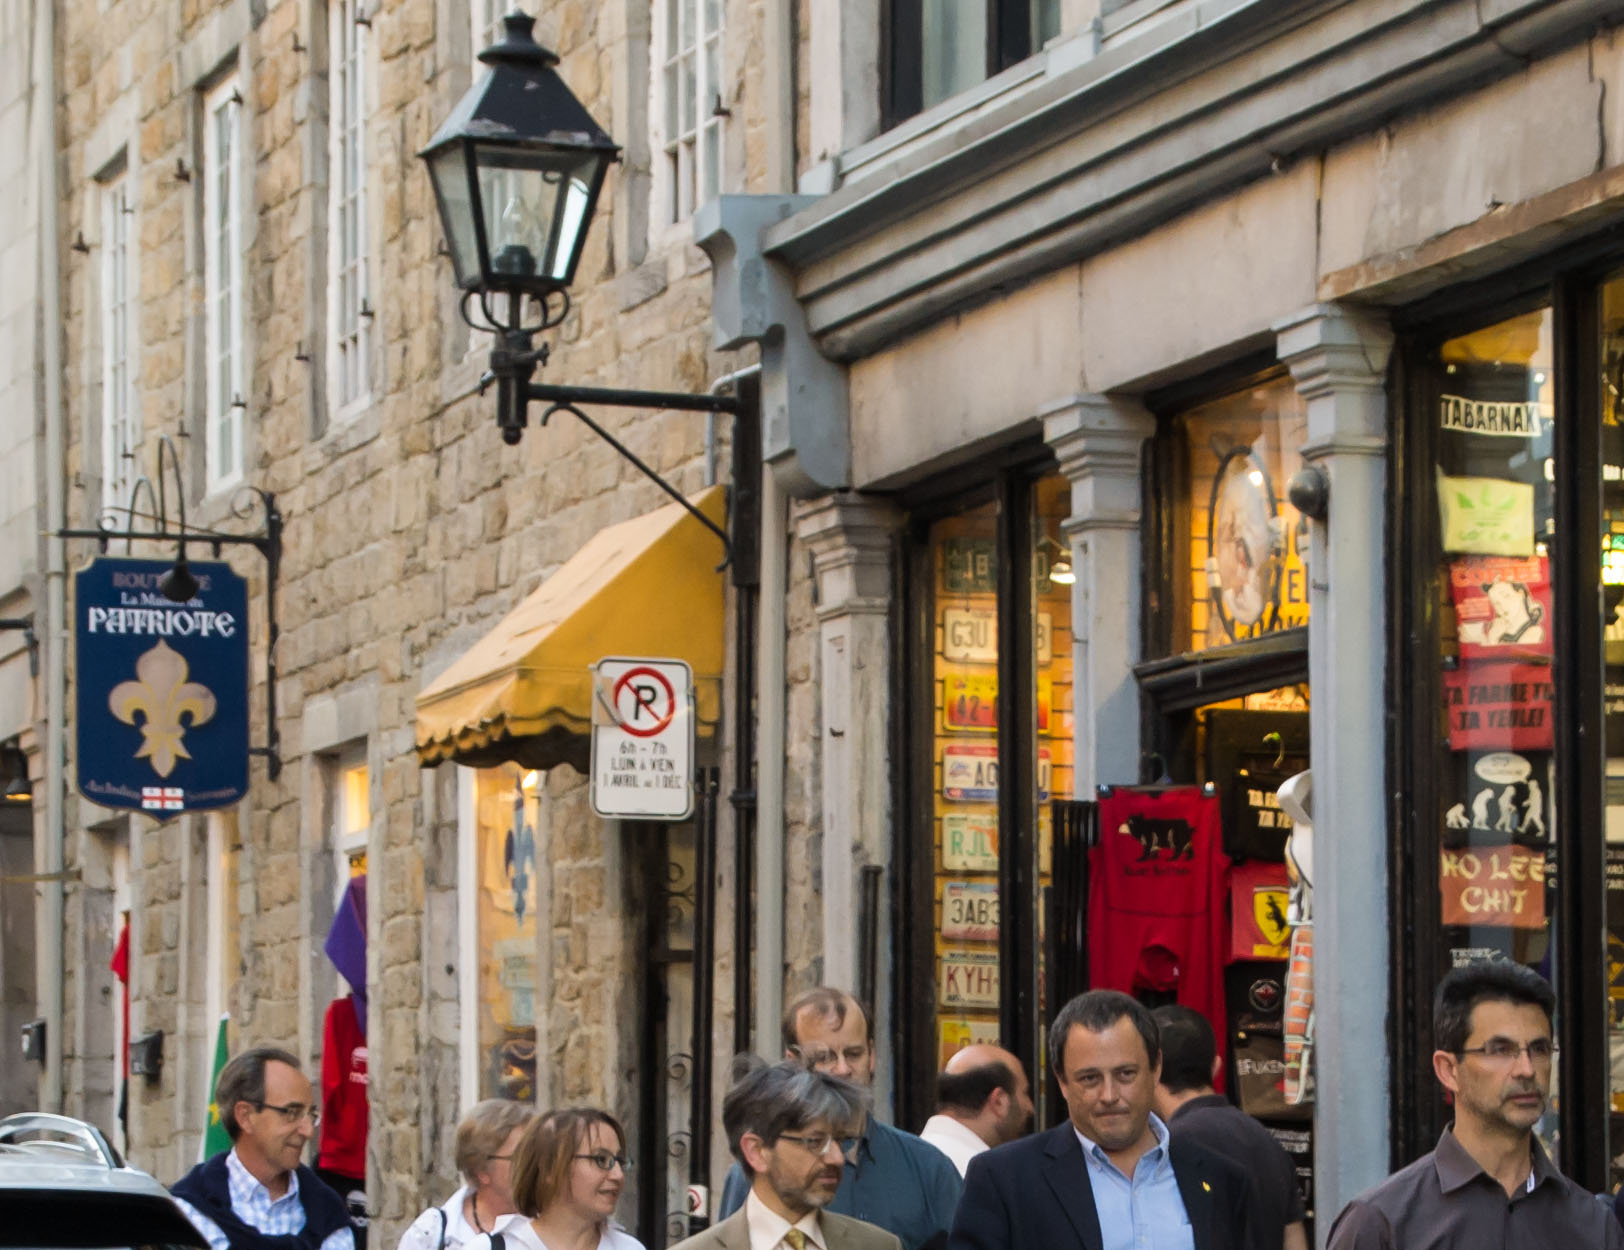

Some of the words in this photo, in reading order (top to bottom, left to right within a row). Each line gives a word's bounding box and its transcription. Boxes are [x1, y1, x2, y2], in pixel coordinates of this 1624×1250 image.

[1441, 400, 1536, 432] TABARNAK
[112, 572, 212, 592] BOUTE
[611, 758, 636, 771] LUN
[651, 758, 675, 773] VEN
[1489, 852, 1546, 882] LEE
[1460, 886, 1528, 914] CHIT
